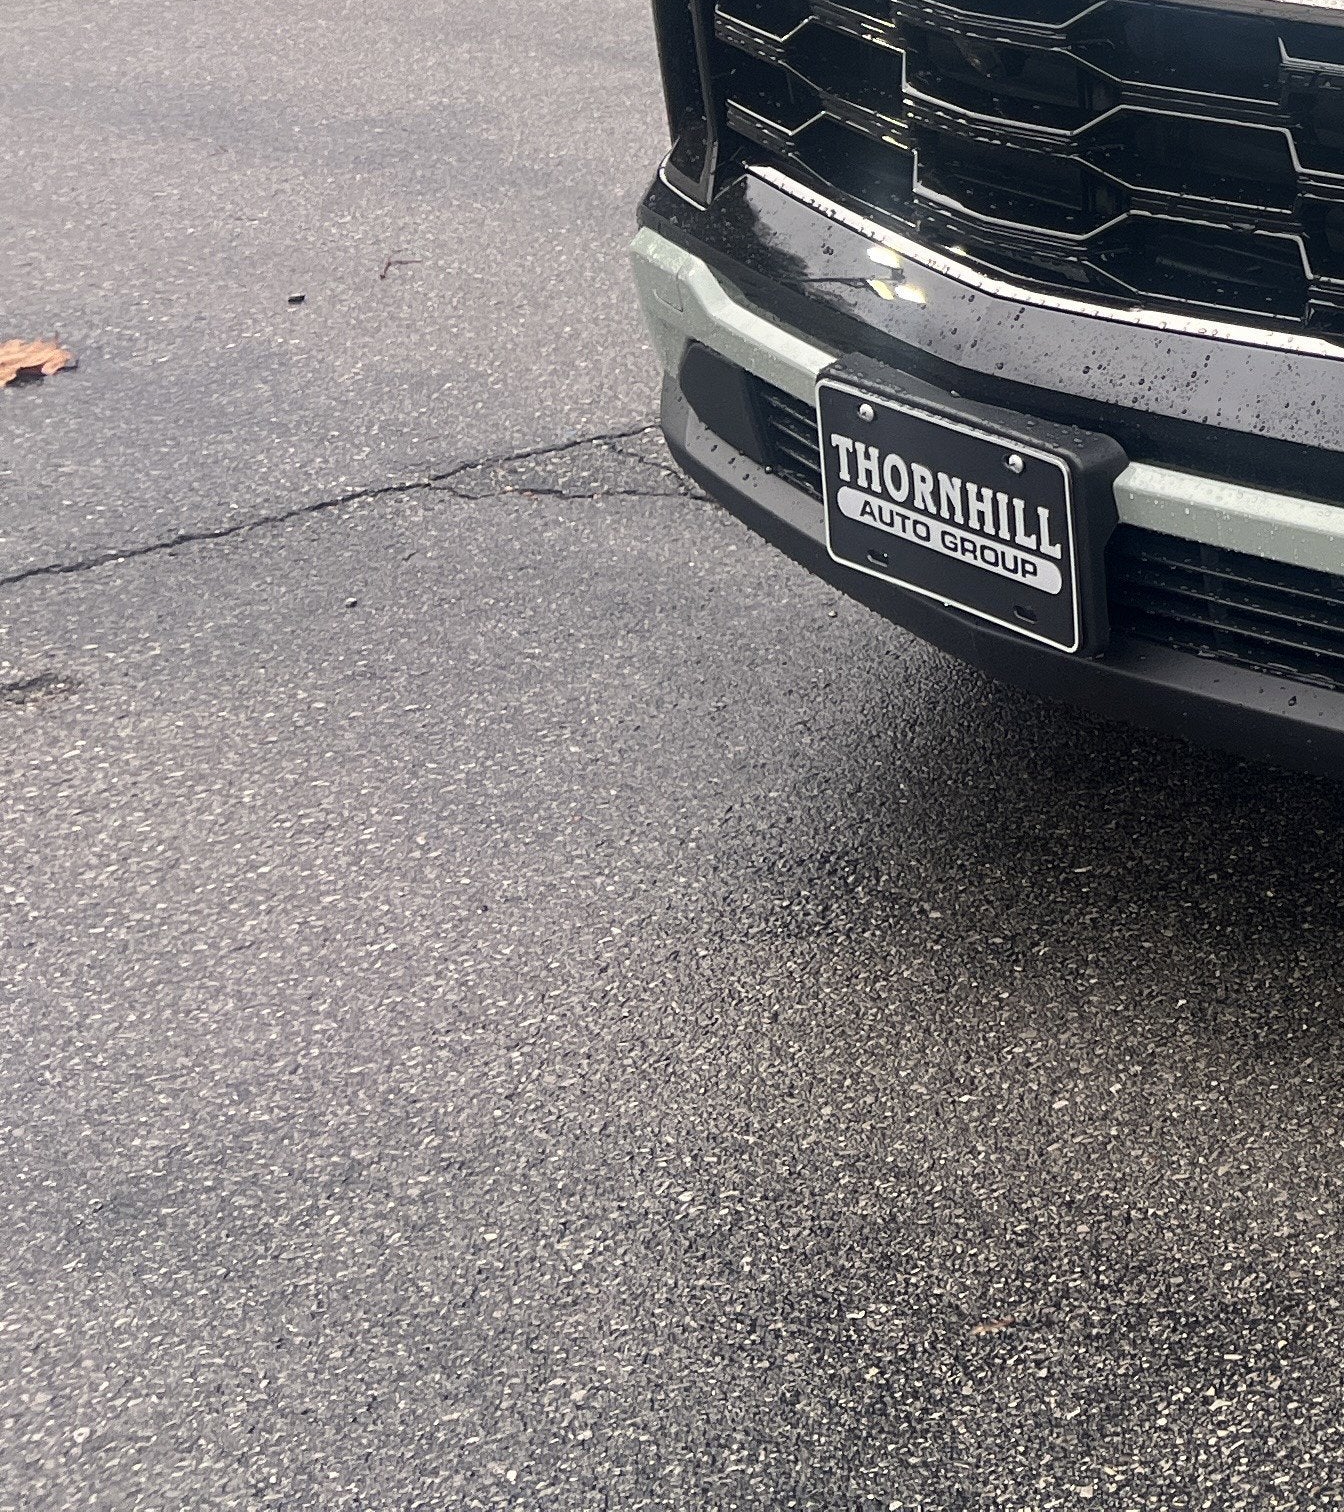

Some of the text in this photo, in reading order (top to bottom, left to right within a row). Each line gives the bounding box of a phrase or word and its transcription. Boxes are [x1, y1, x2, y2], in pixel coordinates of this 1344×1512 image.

[829, 432, 1063, 559] THORNHILL
[858, 497, 1039, 579] AUTO GROUP
